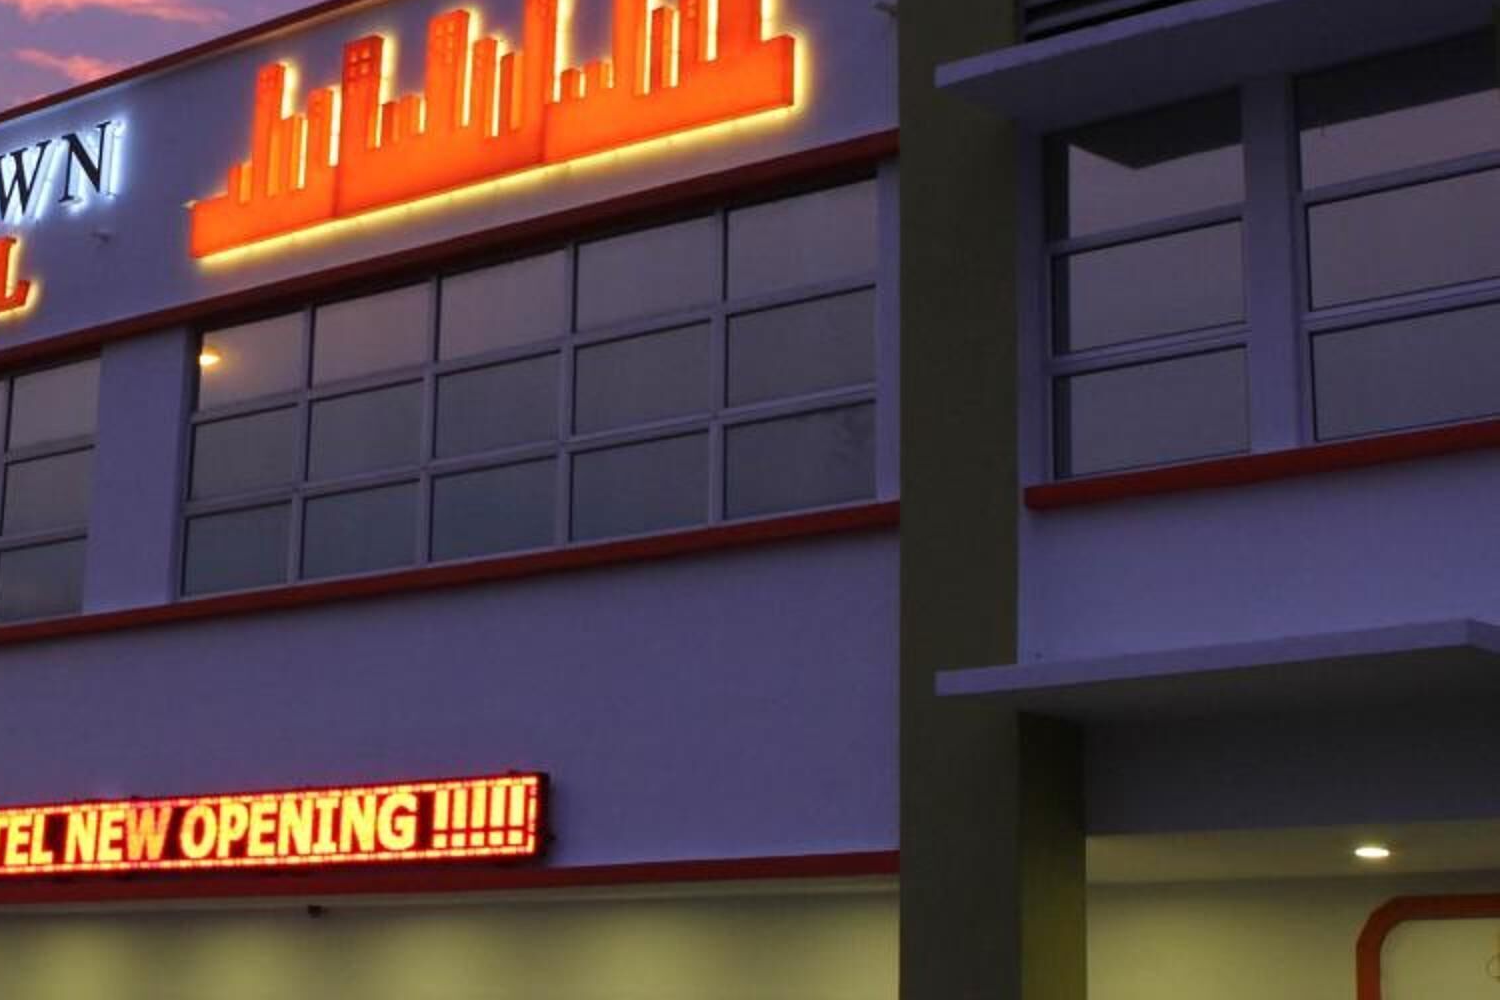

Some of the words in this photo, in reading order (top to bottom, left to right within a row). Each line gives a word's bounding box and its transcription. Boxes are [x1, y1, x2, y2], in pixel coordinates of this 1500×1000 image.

[64, 806, 173, 864] NEW
[180, 792, 418, 859] OPENING
[432, 784, 526, 849] !!!!!
